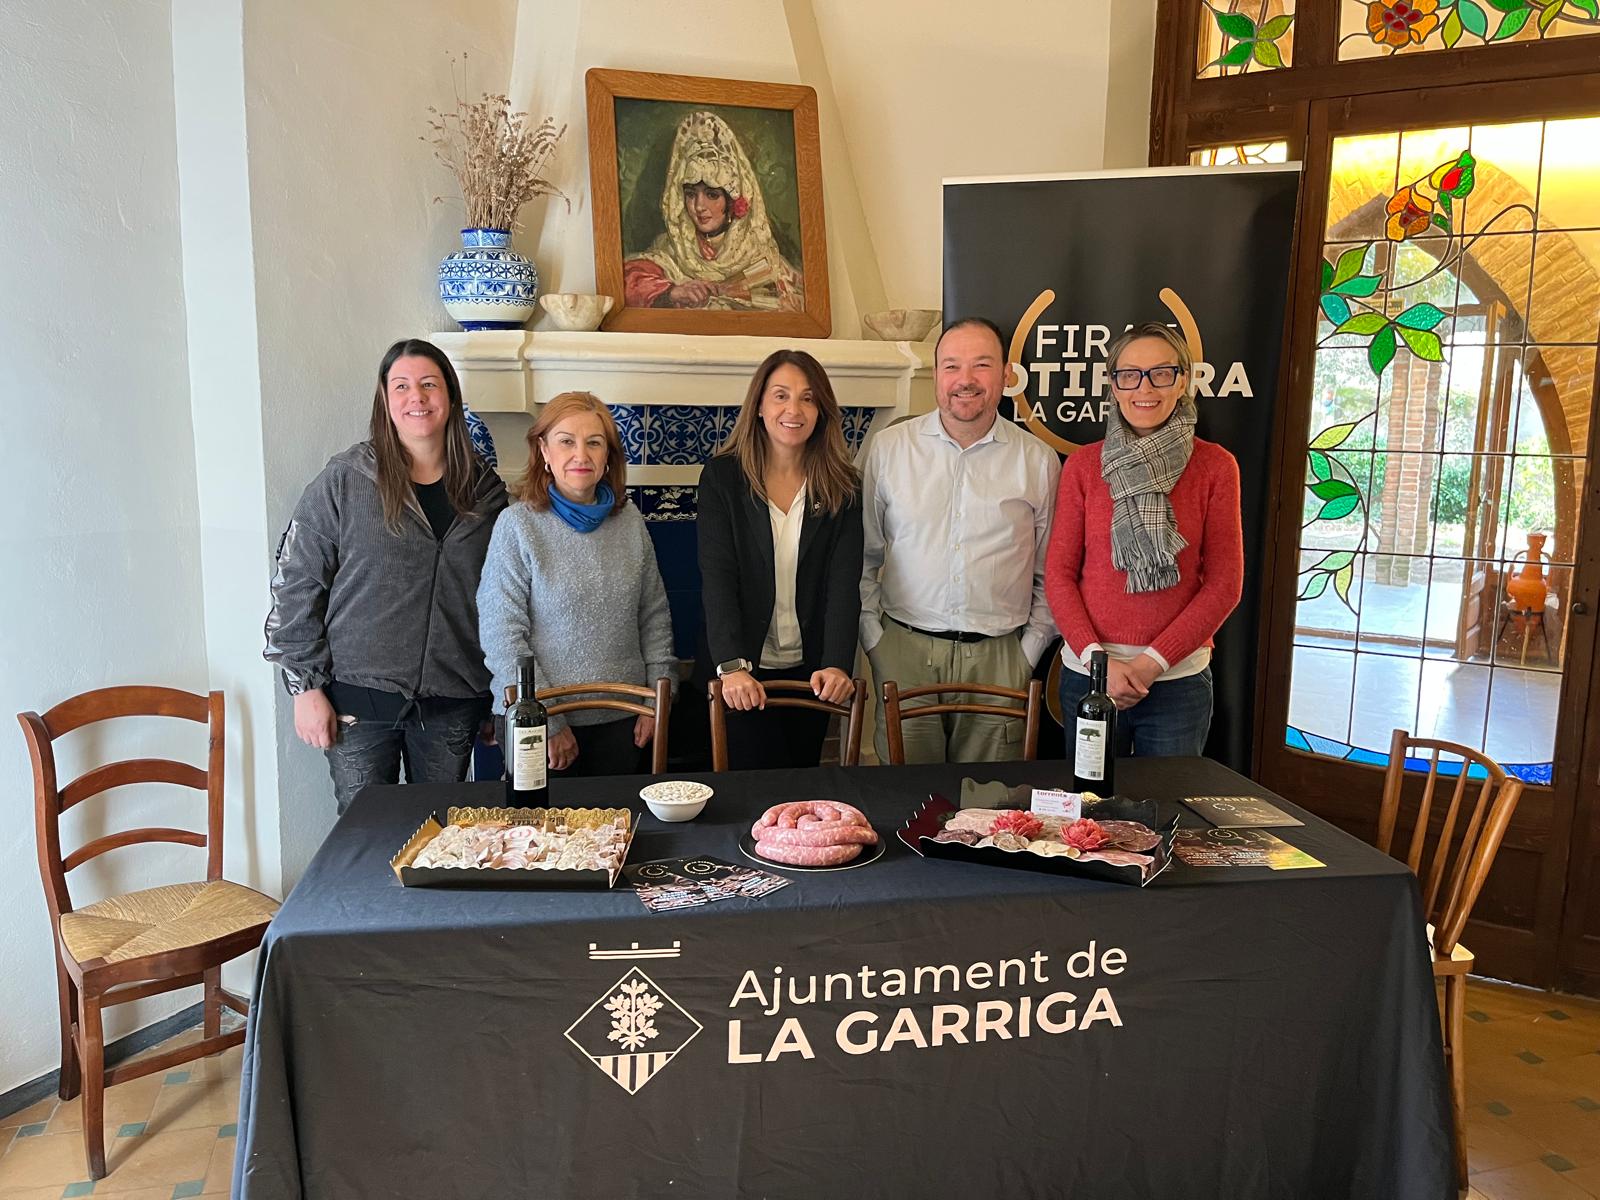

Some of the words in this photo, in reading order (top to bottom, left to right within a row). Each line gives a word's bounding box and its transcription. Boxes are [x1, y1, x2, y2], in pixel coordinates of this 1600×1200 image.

[1036, 324, 1134, 358] FIR
[1013, 401, 1048, 423] LA
[728, 950, 1050, 1016] Ajuntament
[1066, 940, 1128, 979] de
[727, 1017, 816, 1064] LA
[835, 987, 1124, 1056] GARRIGA
